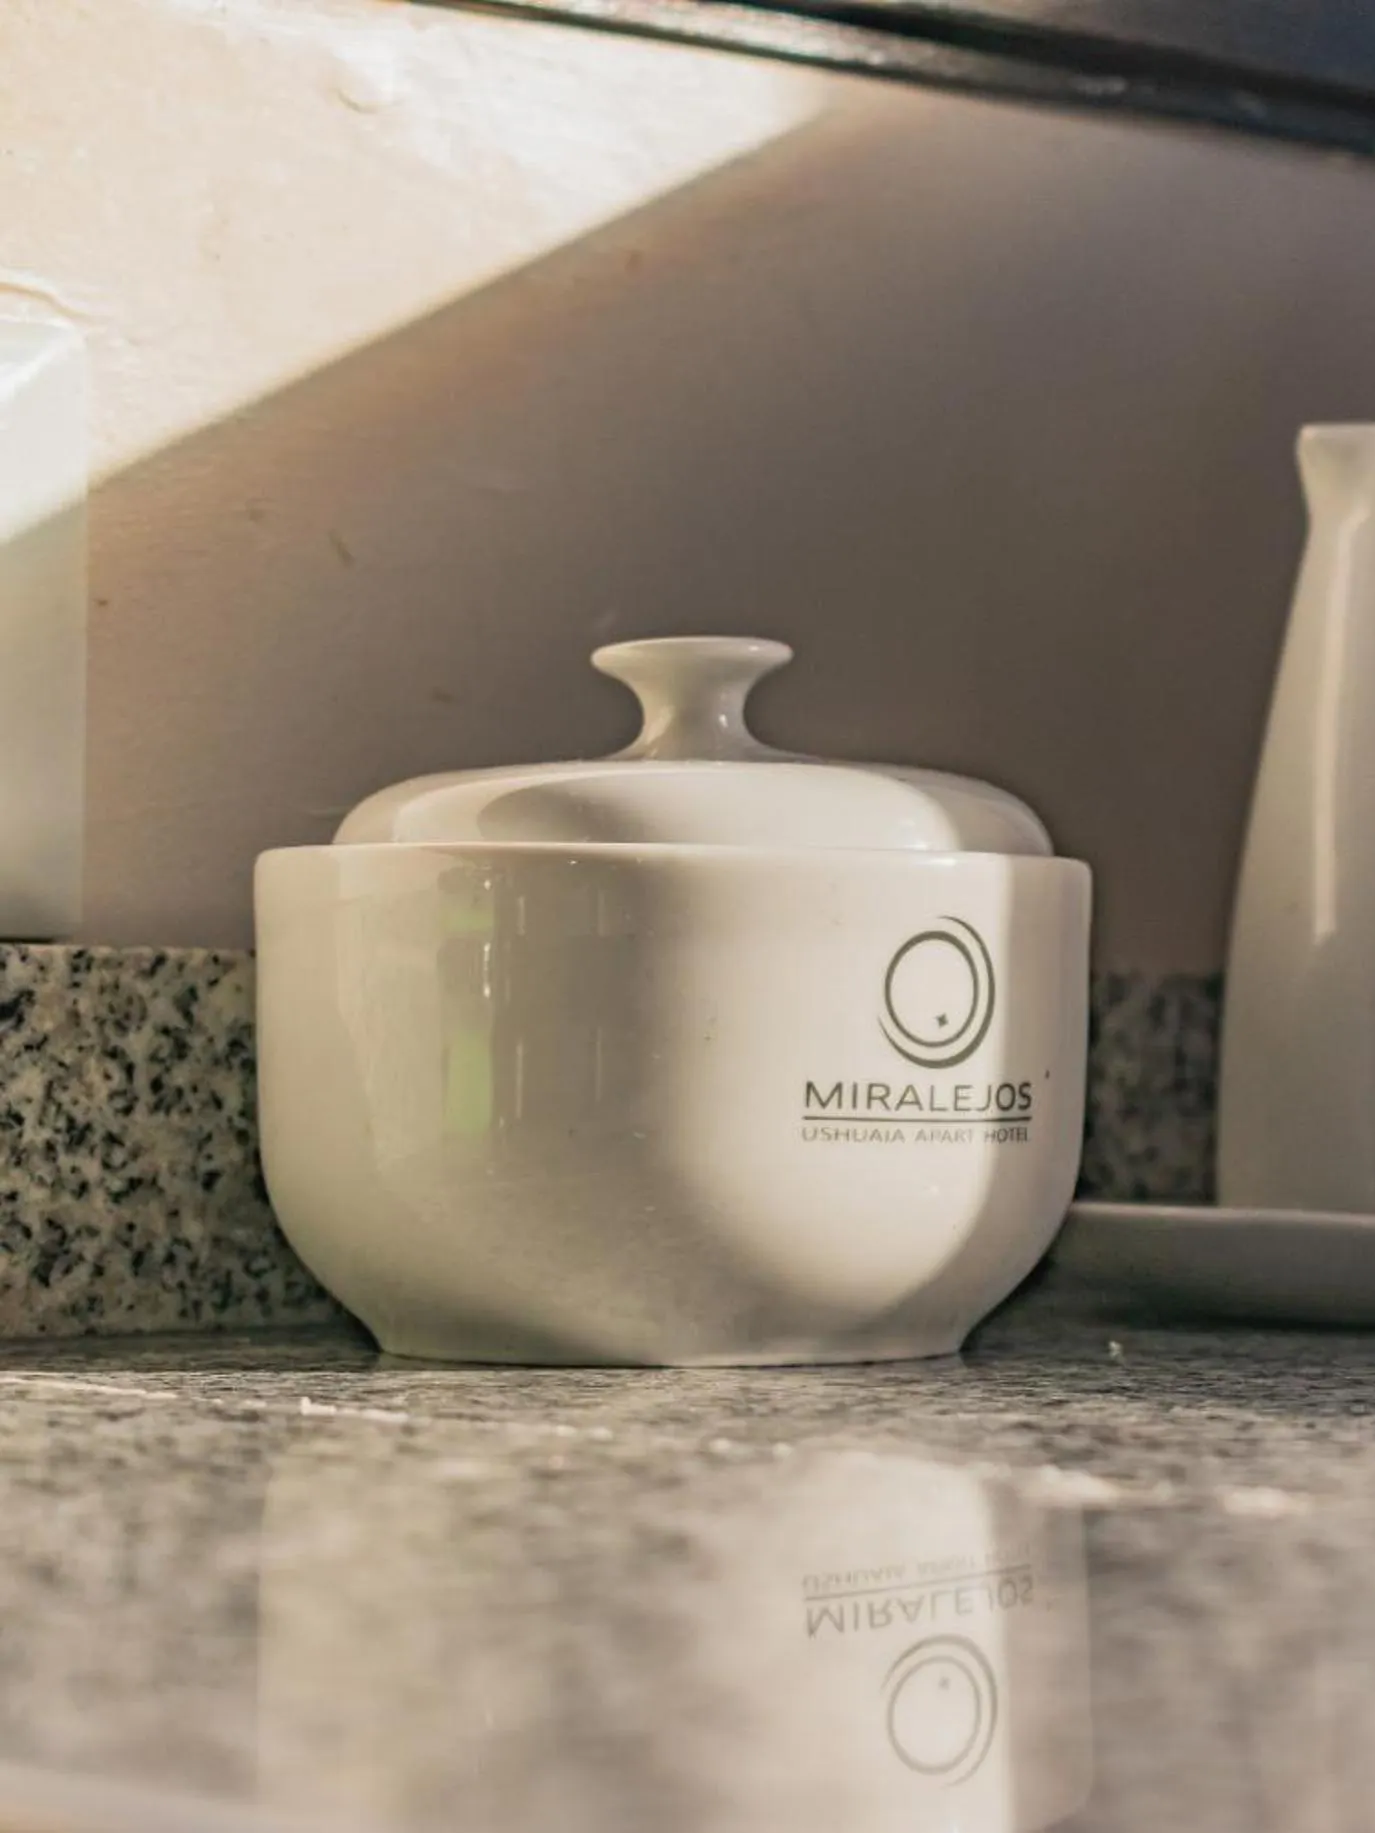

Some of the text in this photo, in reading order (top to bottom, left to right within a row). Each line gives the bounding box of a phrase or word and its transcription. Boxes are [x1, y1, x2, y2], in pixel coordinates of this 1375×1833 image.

[804, 1081, 1032, 1112] MIRALEJOS
[801, 1127, 1030, 1143] USHUAIA APART HOTEL
